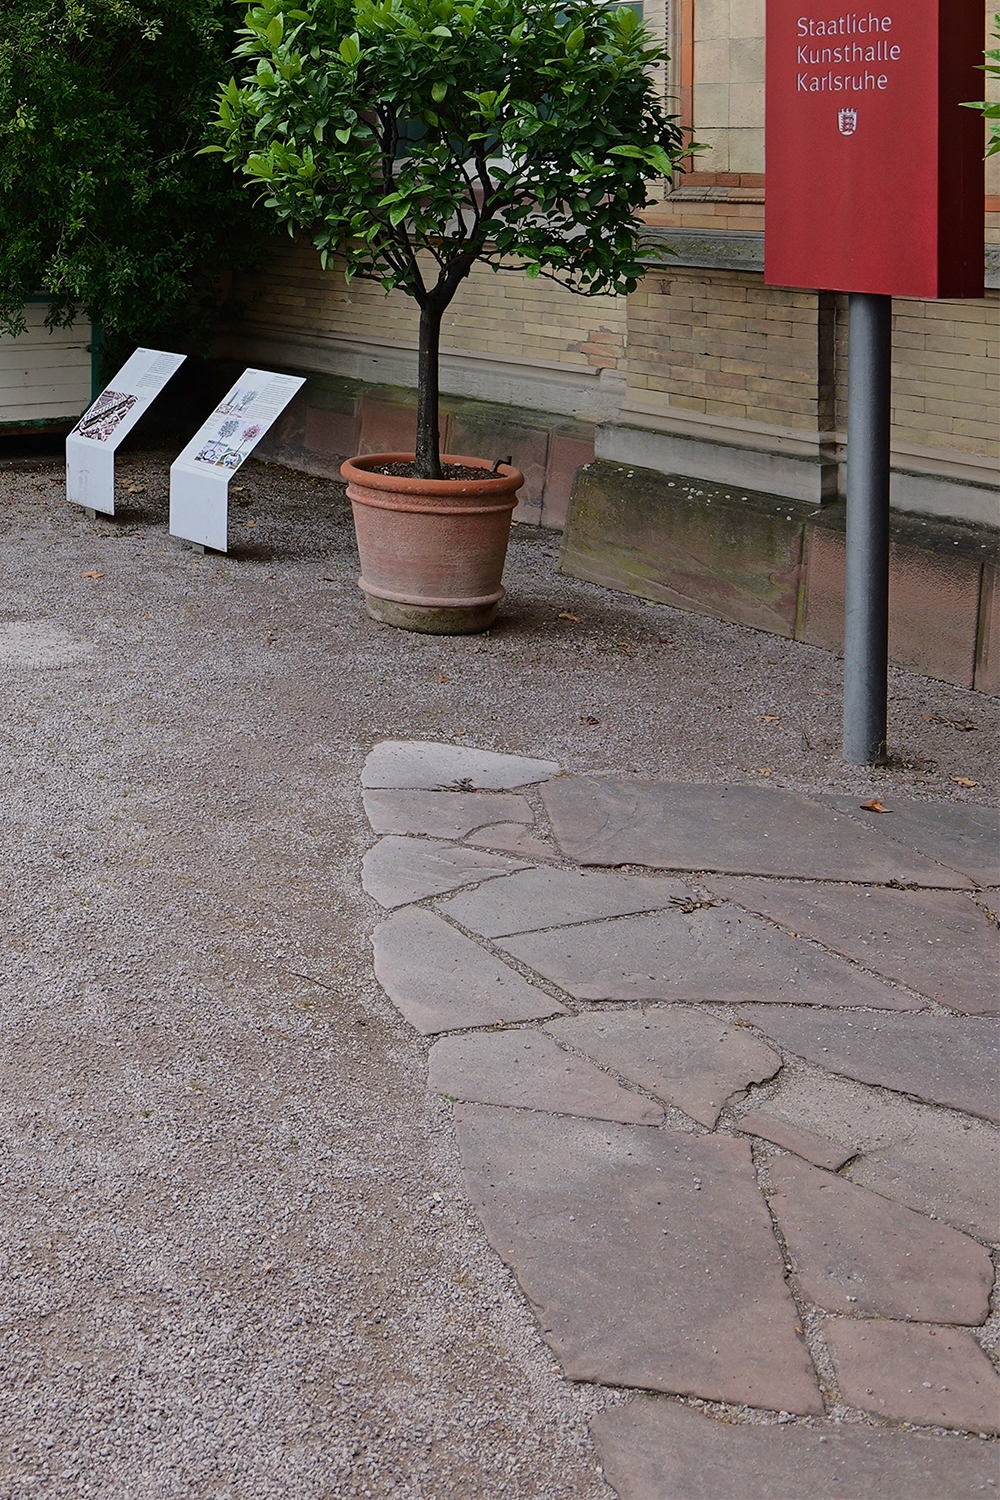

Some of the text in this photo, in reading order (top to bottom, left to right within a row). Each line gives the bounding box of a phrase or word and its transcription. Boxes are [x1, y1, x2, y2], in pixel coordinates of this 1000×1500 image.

[796, 12, 892, 37] Staatliche
[797, 40, 901, 64] Kunsthalle
[797, 70, 888, 92] Karlsruhe
